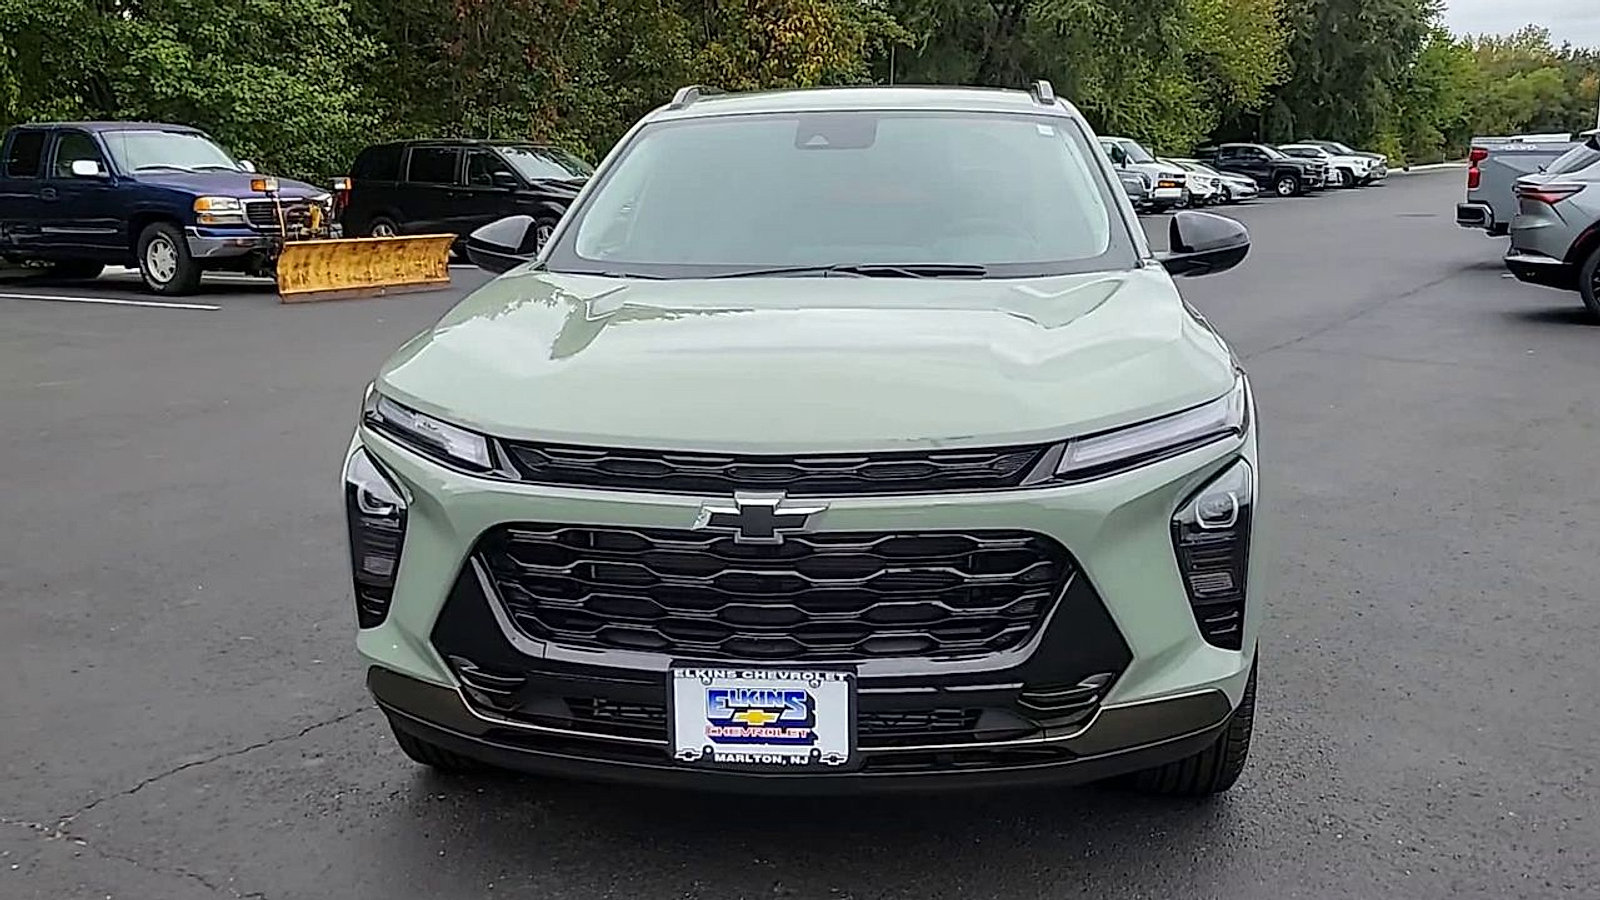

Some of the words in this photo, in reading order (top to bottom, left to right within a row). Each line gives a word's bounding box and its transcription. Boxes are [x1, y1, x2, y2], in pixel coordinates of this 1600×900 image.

[674, 668, 737, 679] ELKINS
[742, 670, 848, 681] CHEVROLET
[706, 688, 808, 721] ELKINS
[705, 726, 811, 739] CHEVROLET
[714, 753, 787, 765] MARLTON,
[790, 754, 809, 765] NJ
